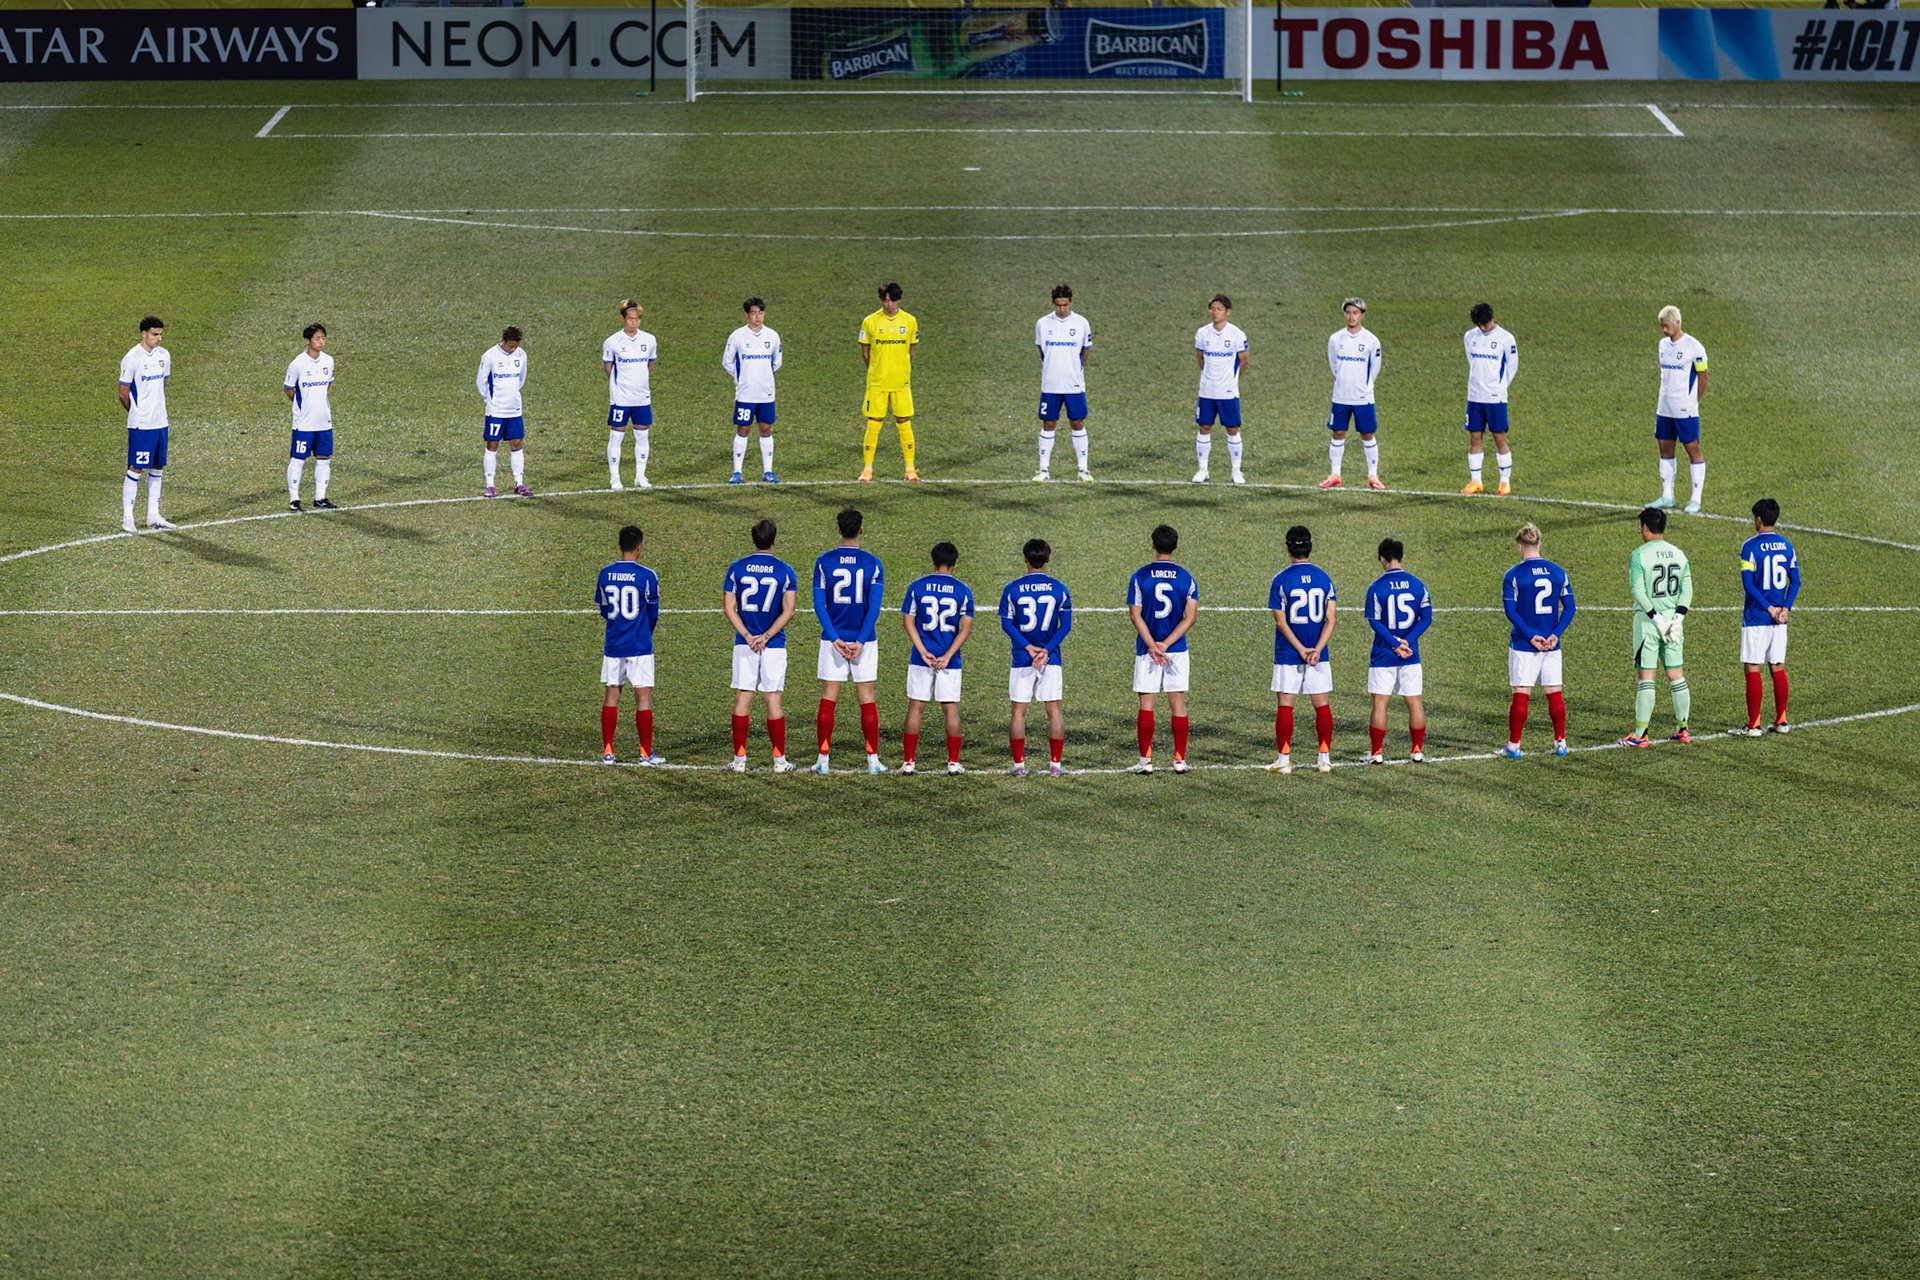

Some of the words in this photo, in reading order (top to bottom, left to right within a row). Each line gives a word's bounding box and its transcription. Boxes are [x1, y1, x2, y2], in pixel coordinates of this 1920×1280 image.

[130, 26, 339, 63] AIRWAYS
[392, 20, 756, 67] NEOM.COM
[831, 42, 909, 78] BARBICAN
[1096, 34, 1198, 55] BARBICAN
[1273, 18, 1610, 70] TOSHIBA
[490, 423, 502, 436] 17
[612, 408, 624, 422] 13
[737, 408, 751, 422] 38
[136, 452, 150, 464] 23
[296, 440, 307, 454] 16
[746, 564, 774, 574] GONDRA
[840, 556, 856, 564] DANI
[1151, 570, 1177, 578] LORENZ
[1532, 567, 1550, 576] HALL
[1762, 554, 1788, 590] 16
[740, 576, 778, 612] 27
[832, 568, 864, 604] 21
[1301, 575, 1312, 584] KU
[1534, 578, 1553, 614] 2
[1652, 564, 1681, 598] 26
[605, 585, 640, 620] 30
[921, 595, 958, 632] 32
[1017, 594, 1056, 632] 37
[1154, 582, 1174, 618] 5
[1290, 588, 1325, 624] 20
[1387, 592, 1416, 630] 15
